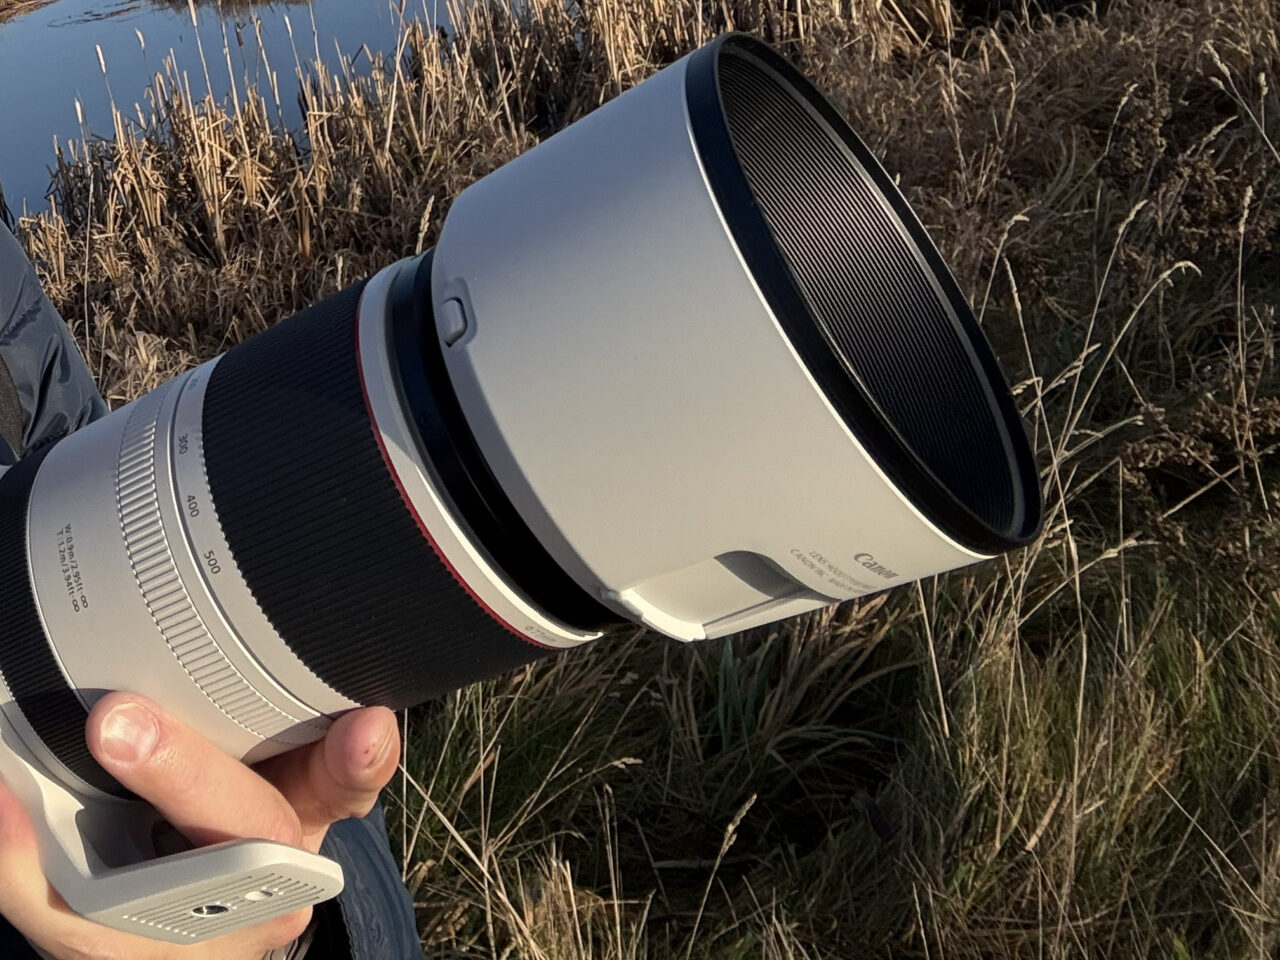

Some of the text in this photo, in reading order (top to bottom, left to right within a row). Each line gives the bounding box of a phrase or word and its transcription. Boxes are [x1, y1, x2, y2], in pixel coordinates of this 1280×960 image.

[179, 434, 189, 455] 300
[187, 494, 200, 518] 400
[204, 550, 221, 575] 500
[854, 552, 899, 579] Canon
